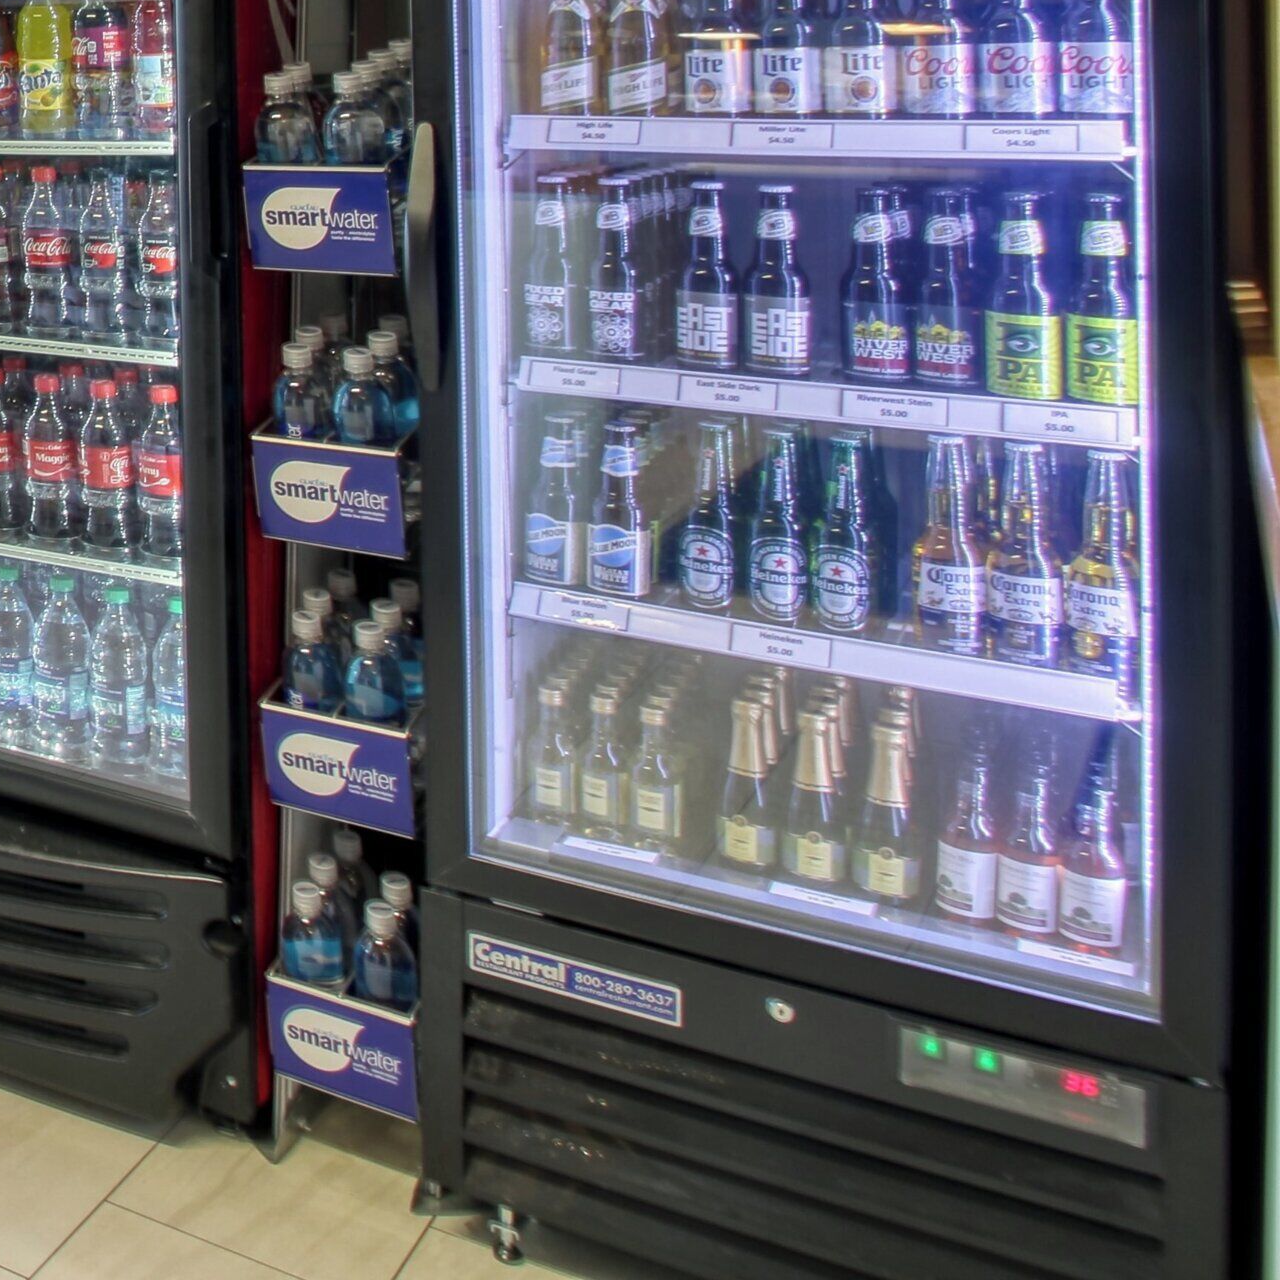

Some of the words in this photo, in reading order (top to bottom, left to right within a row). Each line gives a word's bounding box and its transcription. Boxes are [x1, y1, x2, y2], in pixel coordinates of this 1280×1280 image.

[687, 55, 723, 78] Lite
[762, 53, 803, 76] Lite
[840, 51, 883, 75] Lite
[1070, 74, 1129, 90] LIGHT
[576, 122, 596, 130] High
[759, 125, 786, 133] Miller
[1025, 127, 1050, 137] Light
[525, 284, 565, 295] FIXED
[589, 290, 635, 301] FIXED
[525, 293, 565, 305] GEAR
[590, 299, 633, 310] GEAR
[677, 303, 732, 331] EAST
[751, 308, 809, 336] EAST
[677, 330, 731, 353] SIDE
[751, 335, 808, 358] SIDE
[852, 337, 909, 351] RIVER
[915, 341, 975, 355] RIVER
[853, 347, 907, 361] WEST
[916, 351, 969, 365] WEST
[553, 365, 575, 373] Fixed
[577, 368, 598, 376] Gear
[561, 378, 586, 387] $5.00
[696, 380, 715, 388] East
[718, 381, 736, 389] Side
[739, 383, 761, 392] Dark
[714, 394, 740, 403] $5.00
[857, 394, 906, 404] Riverwest
[907, 397, 933, 406] Stein
[879, 409, 908, 418] $5.00
[1051, 411, 1069, 419] IPA
[1045, 424, 1074, 433] $5.00
[35, 451, 70, 464] Maggie
[541, 528, 567, 538] MOON
[611, 538, 637, 549] MOON
[680, 554, 733, 574] Heineken
[751, 569, 807, 584] Heineken
[814, 576, 868, 595] Heineken
[581, 600, 607, 609] Moon
[1004, 592, 1041, 607] Extra
[1072, 602, 1106, 617] Extra
[759, 631, 804, 645] Heineken
[766, 645, 793, 657] $5.00
[474, 941, 567, 983] Central
[476, 959, 524, 978] RESTAURANT
[524, 971, 566, 990] PRODUCTS
[574, 971, 674, 1007] 800-289-3637
[574, 983, 674, 1016] centralrestaurant.com
[1062, 1069, 1101, 1097] 36
